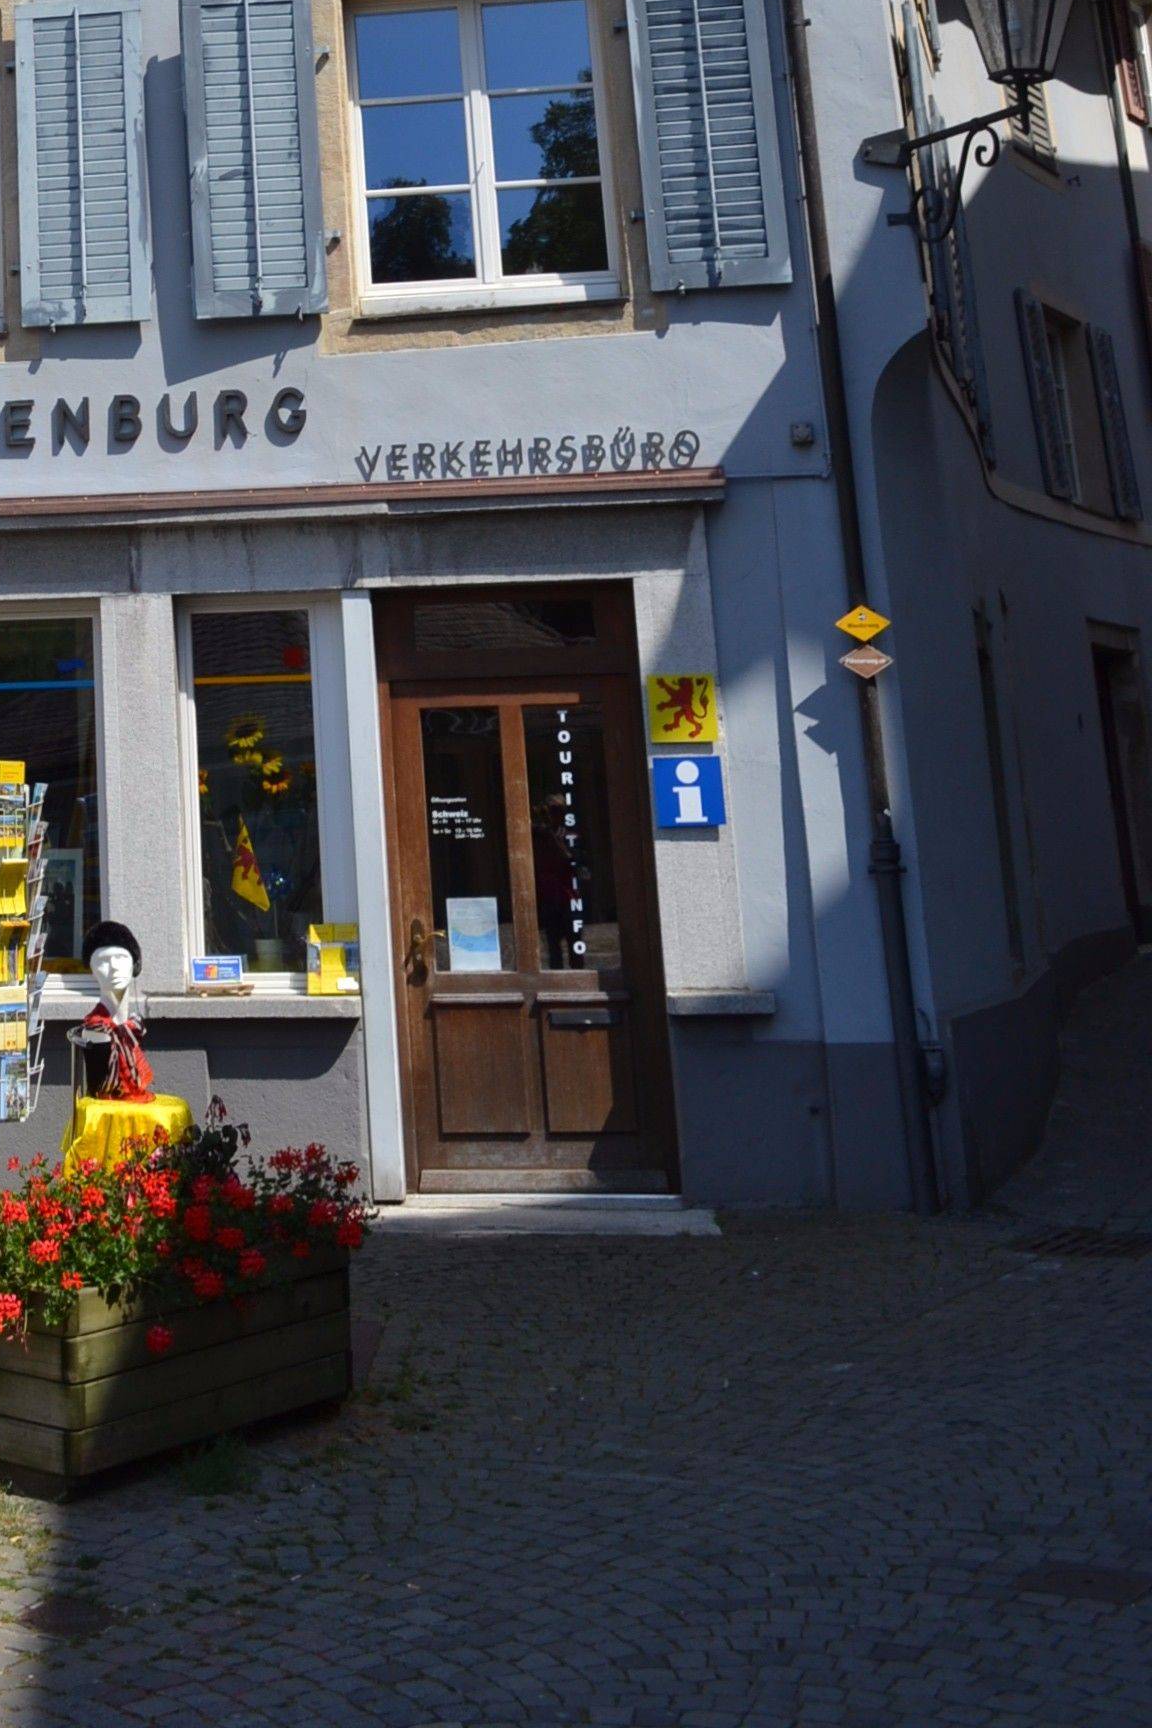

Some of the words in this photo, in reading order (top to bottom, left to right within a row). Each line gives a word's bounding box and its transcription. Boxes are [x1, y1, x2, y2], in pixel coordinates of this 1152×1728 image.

[359, 426, 701, 472] VERKEHRSBÜRO
[432, 810, 468, 818] Schweiz
[557, 709, 587, 955] TOURIST-INFO
